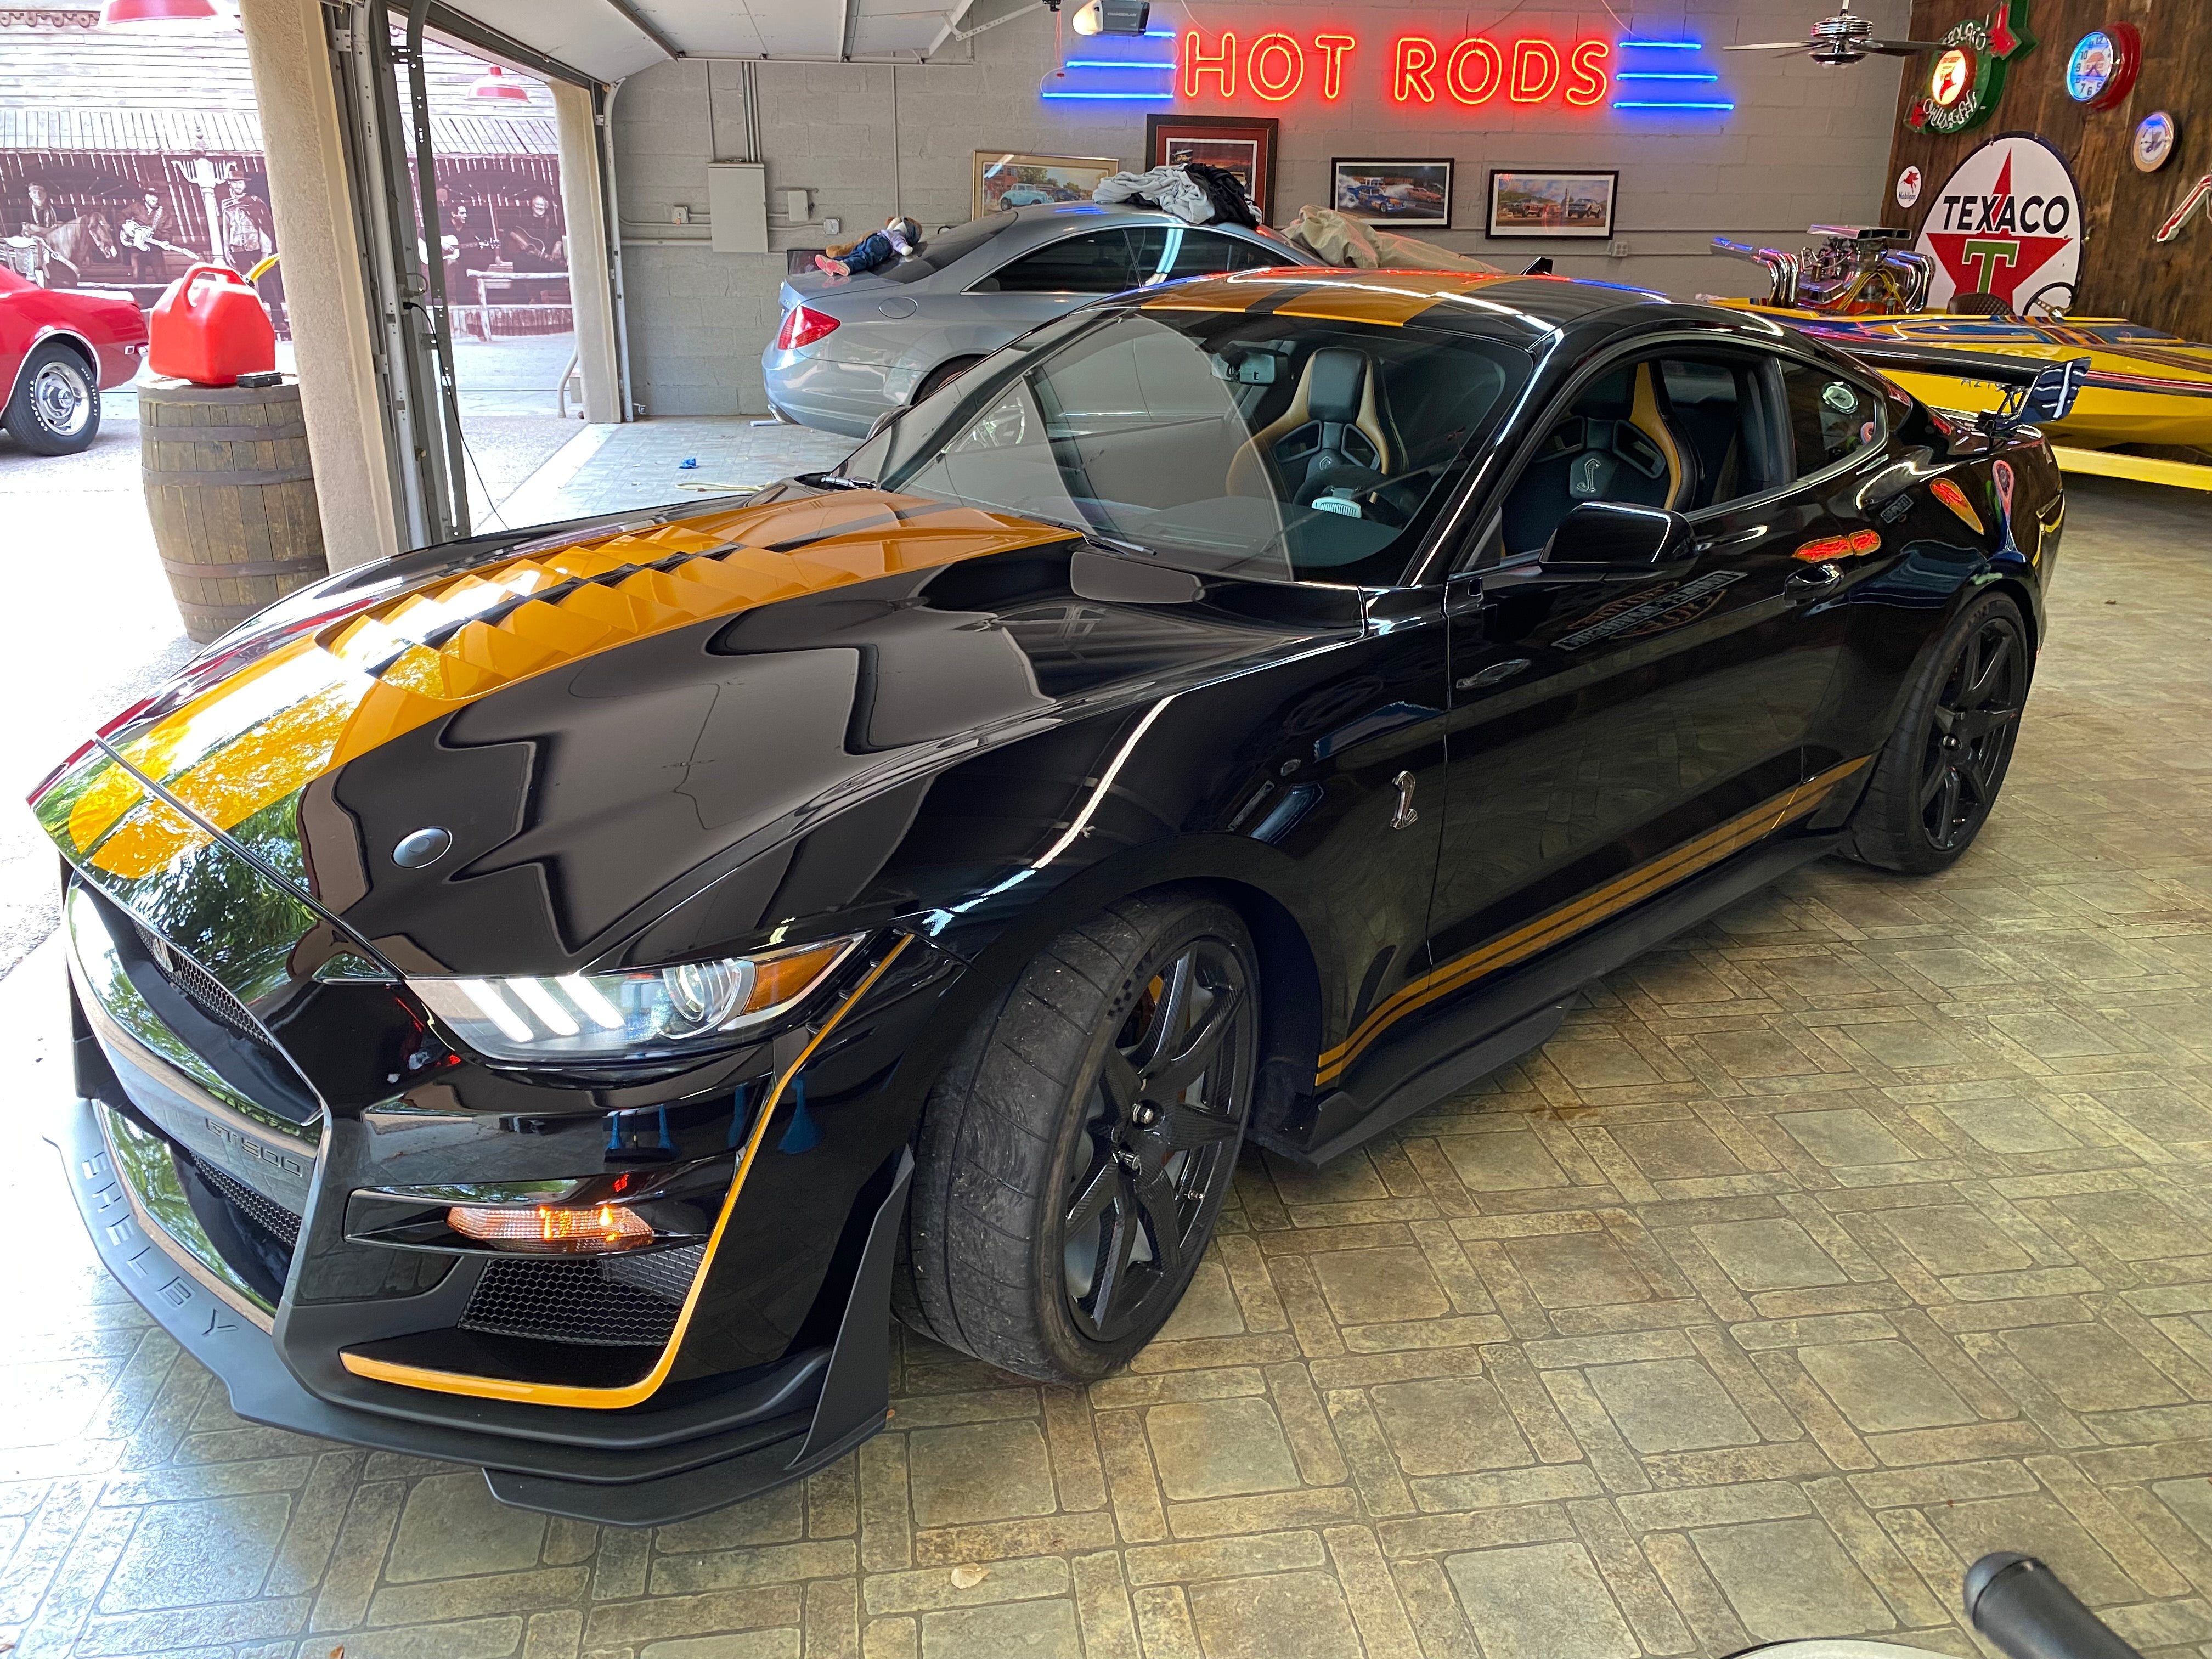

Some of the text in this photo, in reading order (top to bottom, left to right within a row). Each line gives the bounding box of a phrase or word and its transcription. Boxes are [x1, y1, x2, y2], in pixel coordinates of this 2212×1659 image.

[1184, 31, 1609, 106] HOT RODS
[1943, 195, 2070, 235] TEXACO
[1962, 239, 2021, 295] T
[205, 1117, 303, 1177] GT500
[81, 1151, 239, 1338] SHELBY
